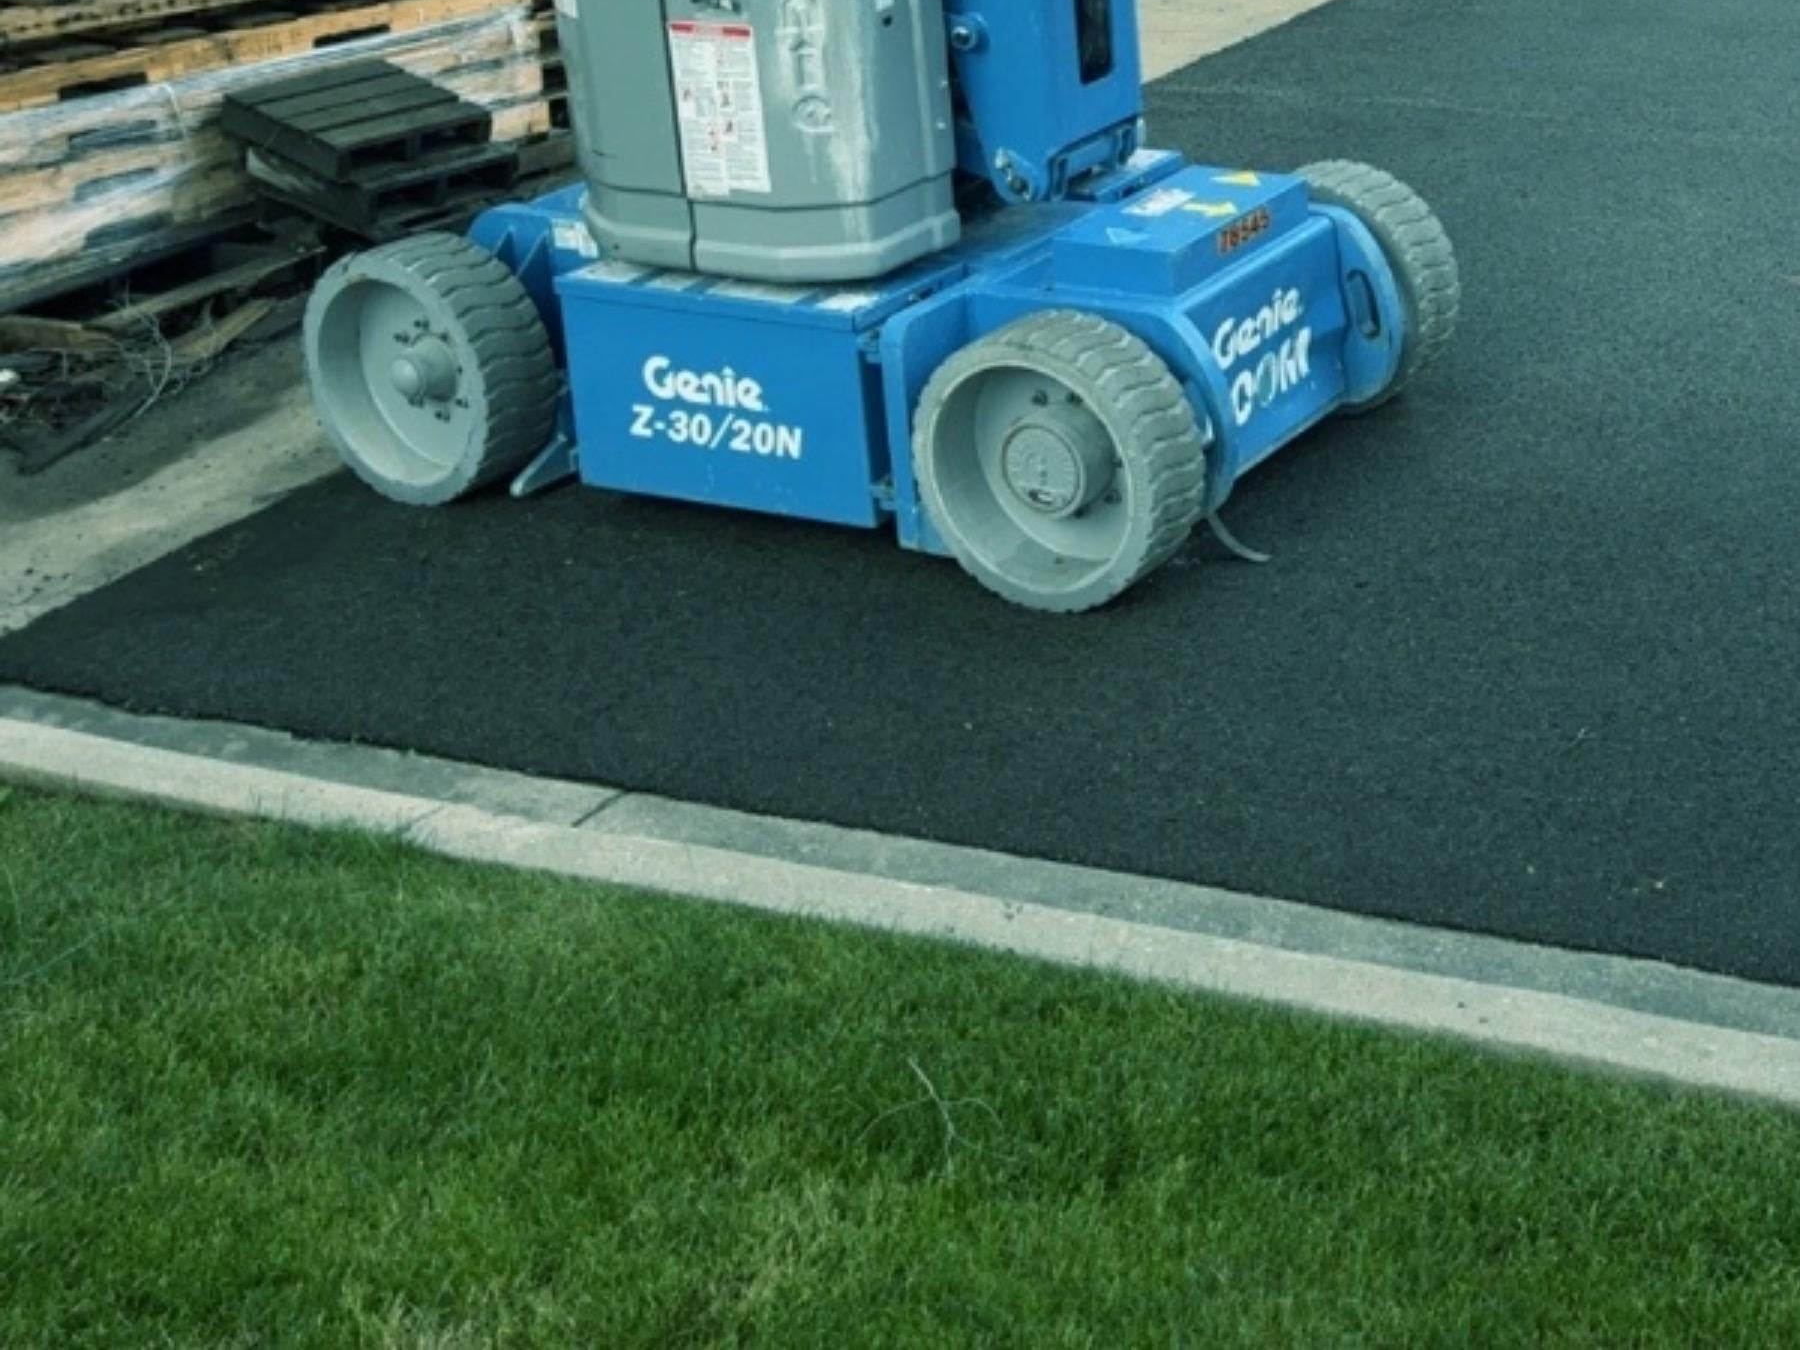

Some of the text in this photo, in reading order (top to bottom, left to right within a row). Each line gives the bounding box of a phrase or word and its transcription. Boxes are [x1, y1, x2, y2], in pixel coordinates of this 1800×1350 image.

[1213, 287, 1299, 370] Genie
[641, 354, 765, 413] Genie
[629, 404, 802, 460] Z-30/20N
